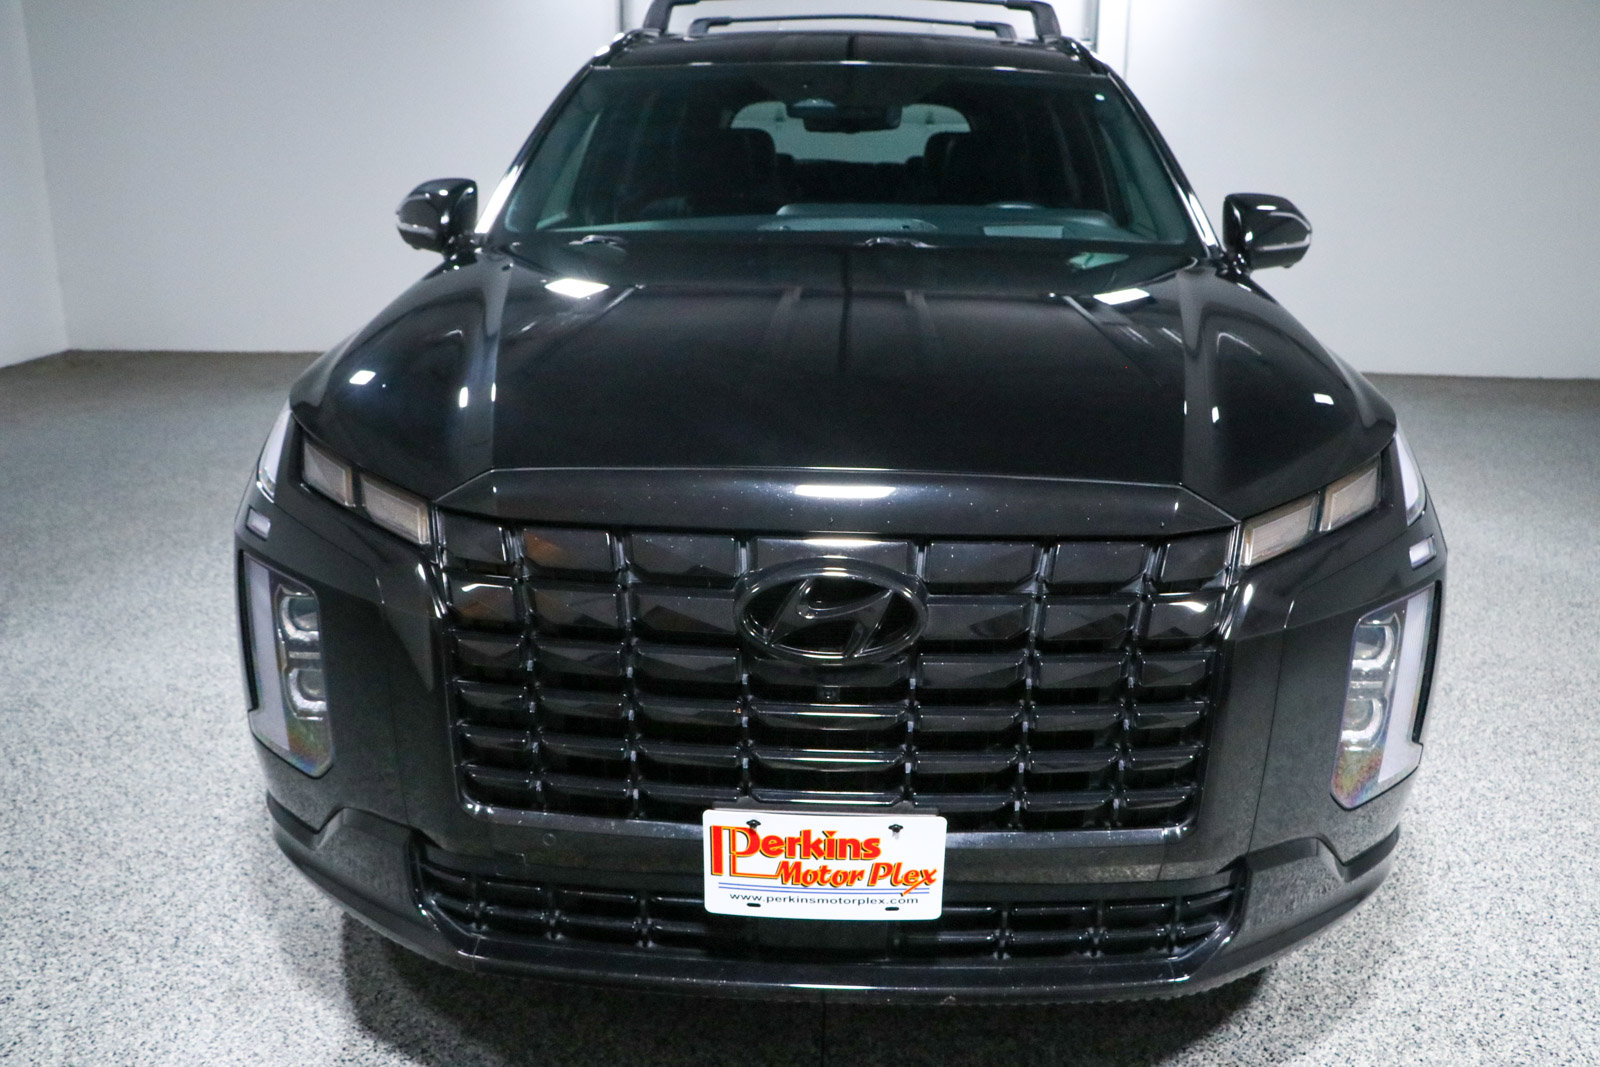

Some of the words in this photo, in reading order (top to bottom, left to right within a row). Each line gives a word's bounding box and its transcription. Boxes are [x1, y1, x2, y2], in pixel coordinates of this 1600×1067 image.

[710, 825, 882, 876] Perkins
[777, 860, 865, 887] Motor
[868, 861, 937, 896] Plex
[729, 892, 919, 906] www.perkinsmotorplex.com
